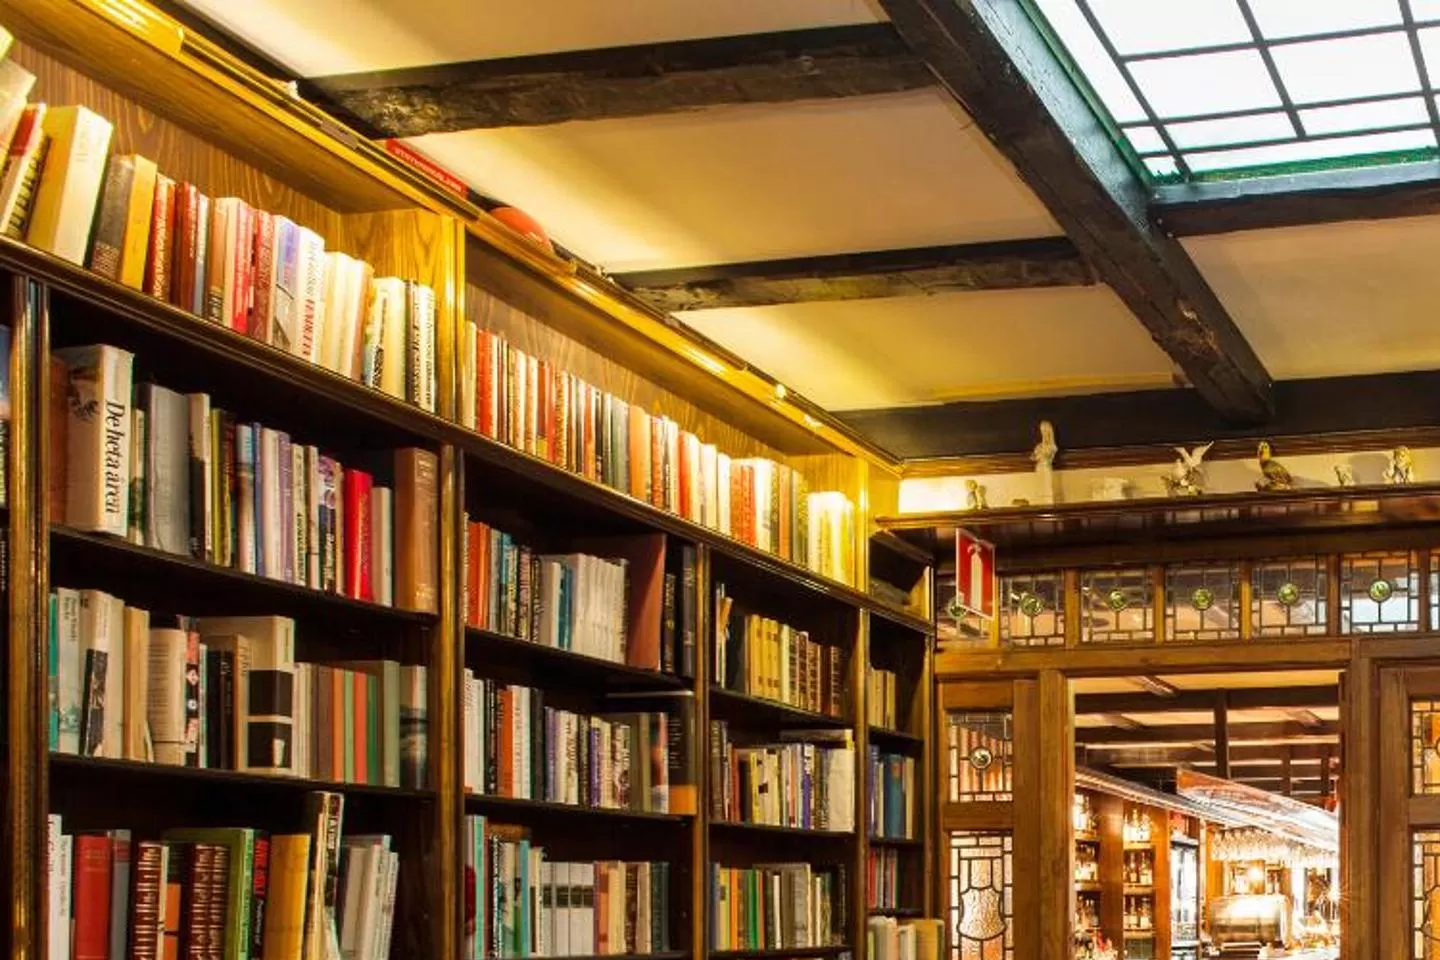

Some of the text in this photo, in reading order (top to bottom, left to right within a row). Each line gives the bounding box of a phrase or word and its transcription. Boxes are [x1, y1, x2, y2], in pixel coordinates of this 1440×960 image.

[105, 400, 125, 515] De heta åren
